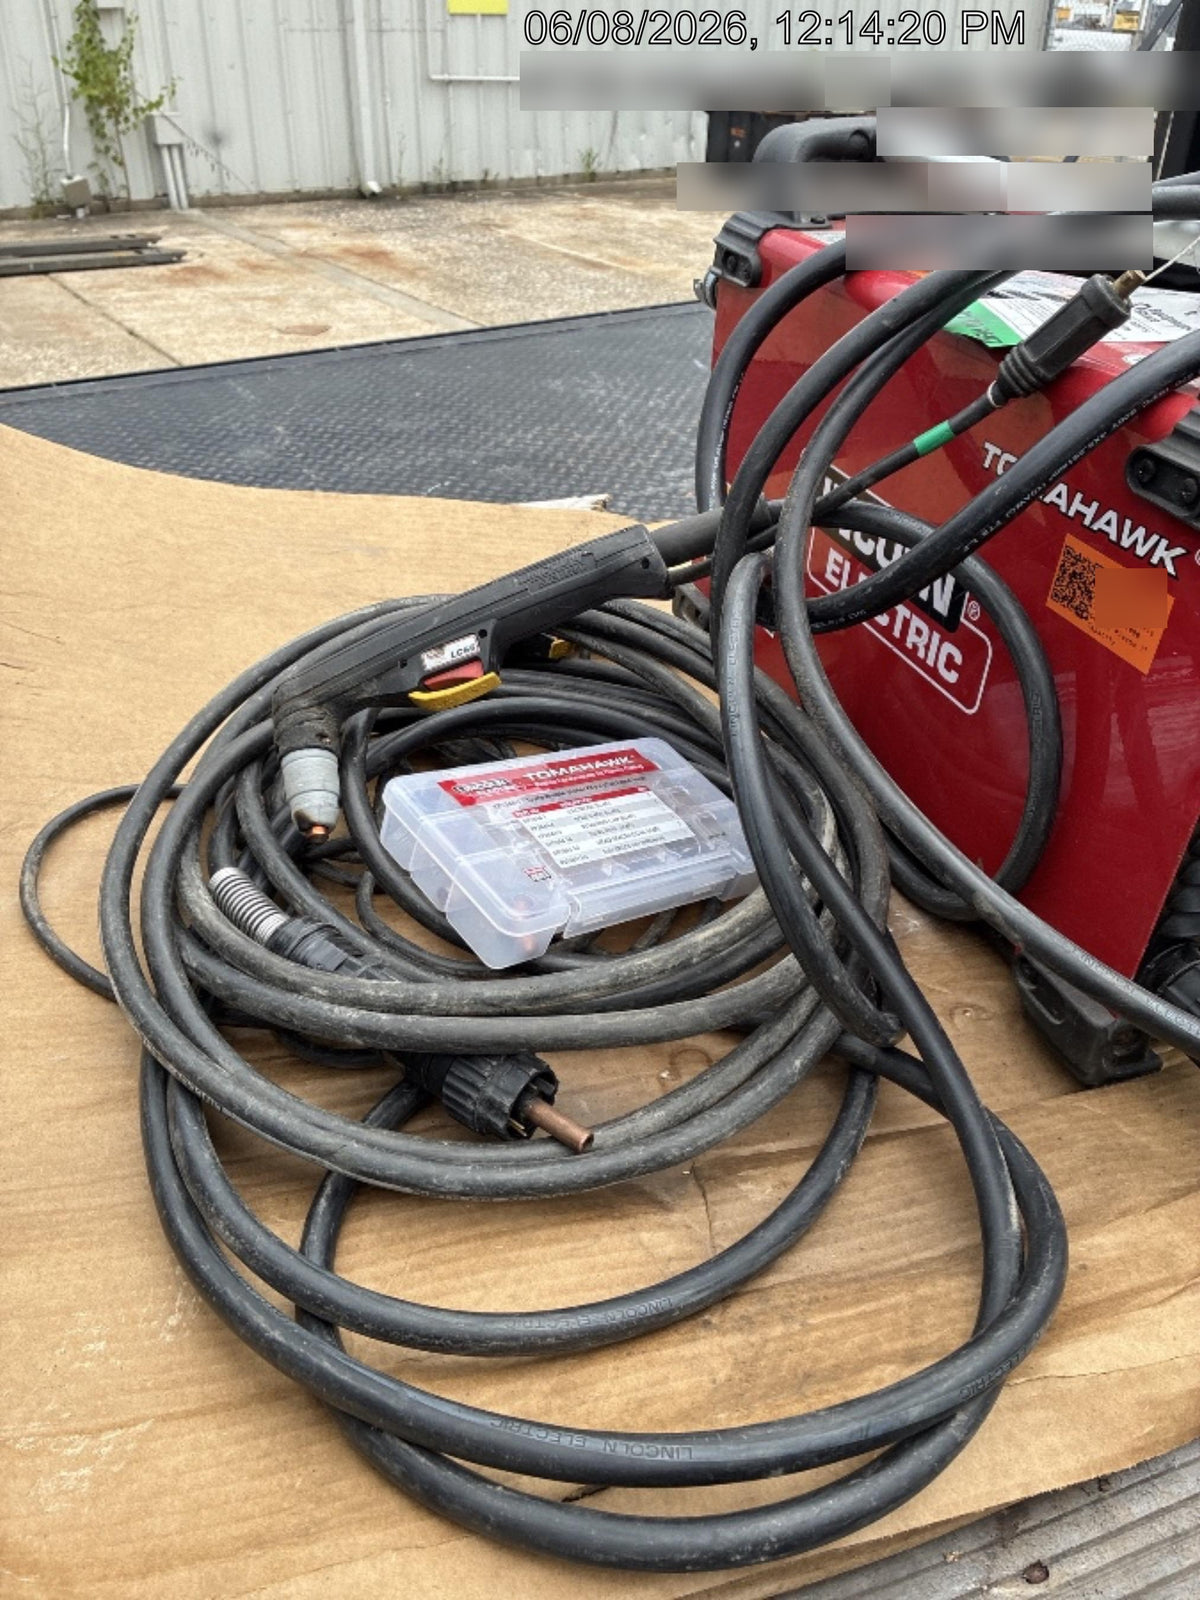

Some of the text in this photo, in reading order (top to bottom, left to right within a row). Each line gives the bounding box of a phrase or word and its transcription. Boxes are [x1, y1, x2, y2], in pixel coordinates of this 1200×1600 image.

[983, 441, 1188, 577] TOAHAWK
[825, 547, 963, 684] ELTRIC
[523, 756, 634, 781] TOMAHAWK
[490, 1416, 694, 1460] LINCOLN ELECTRIC
